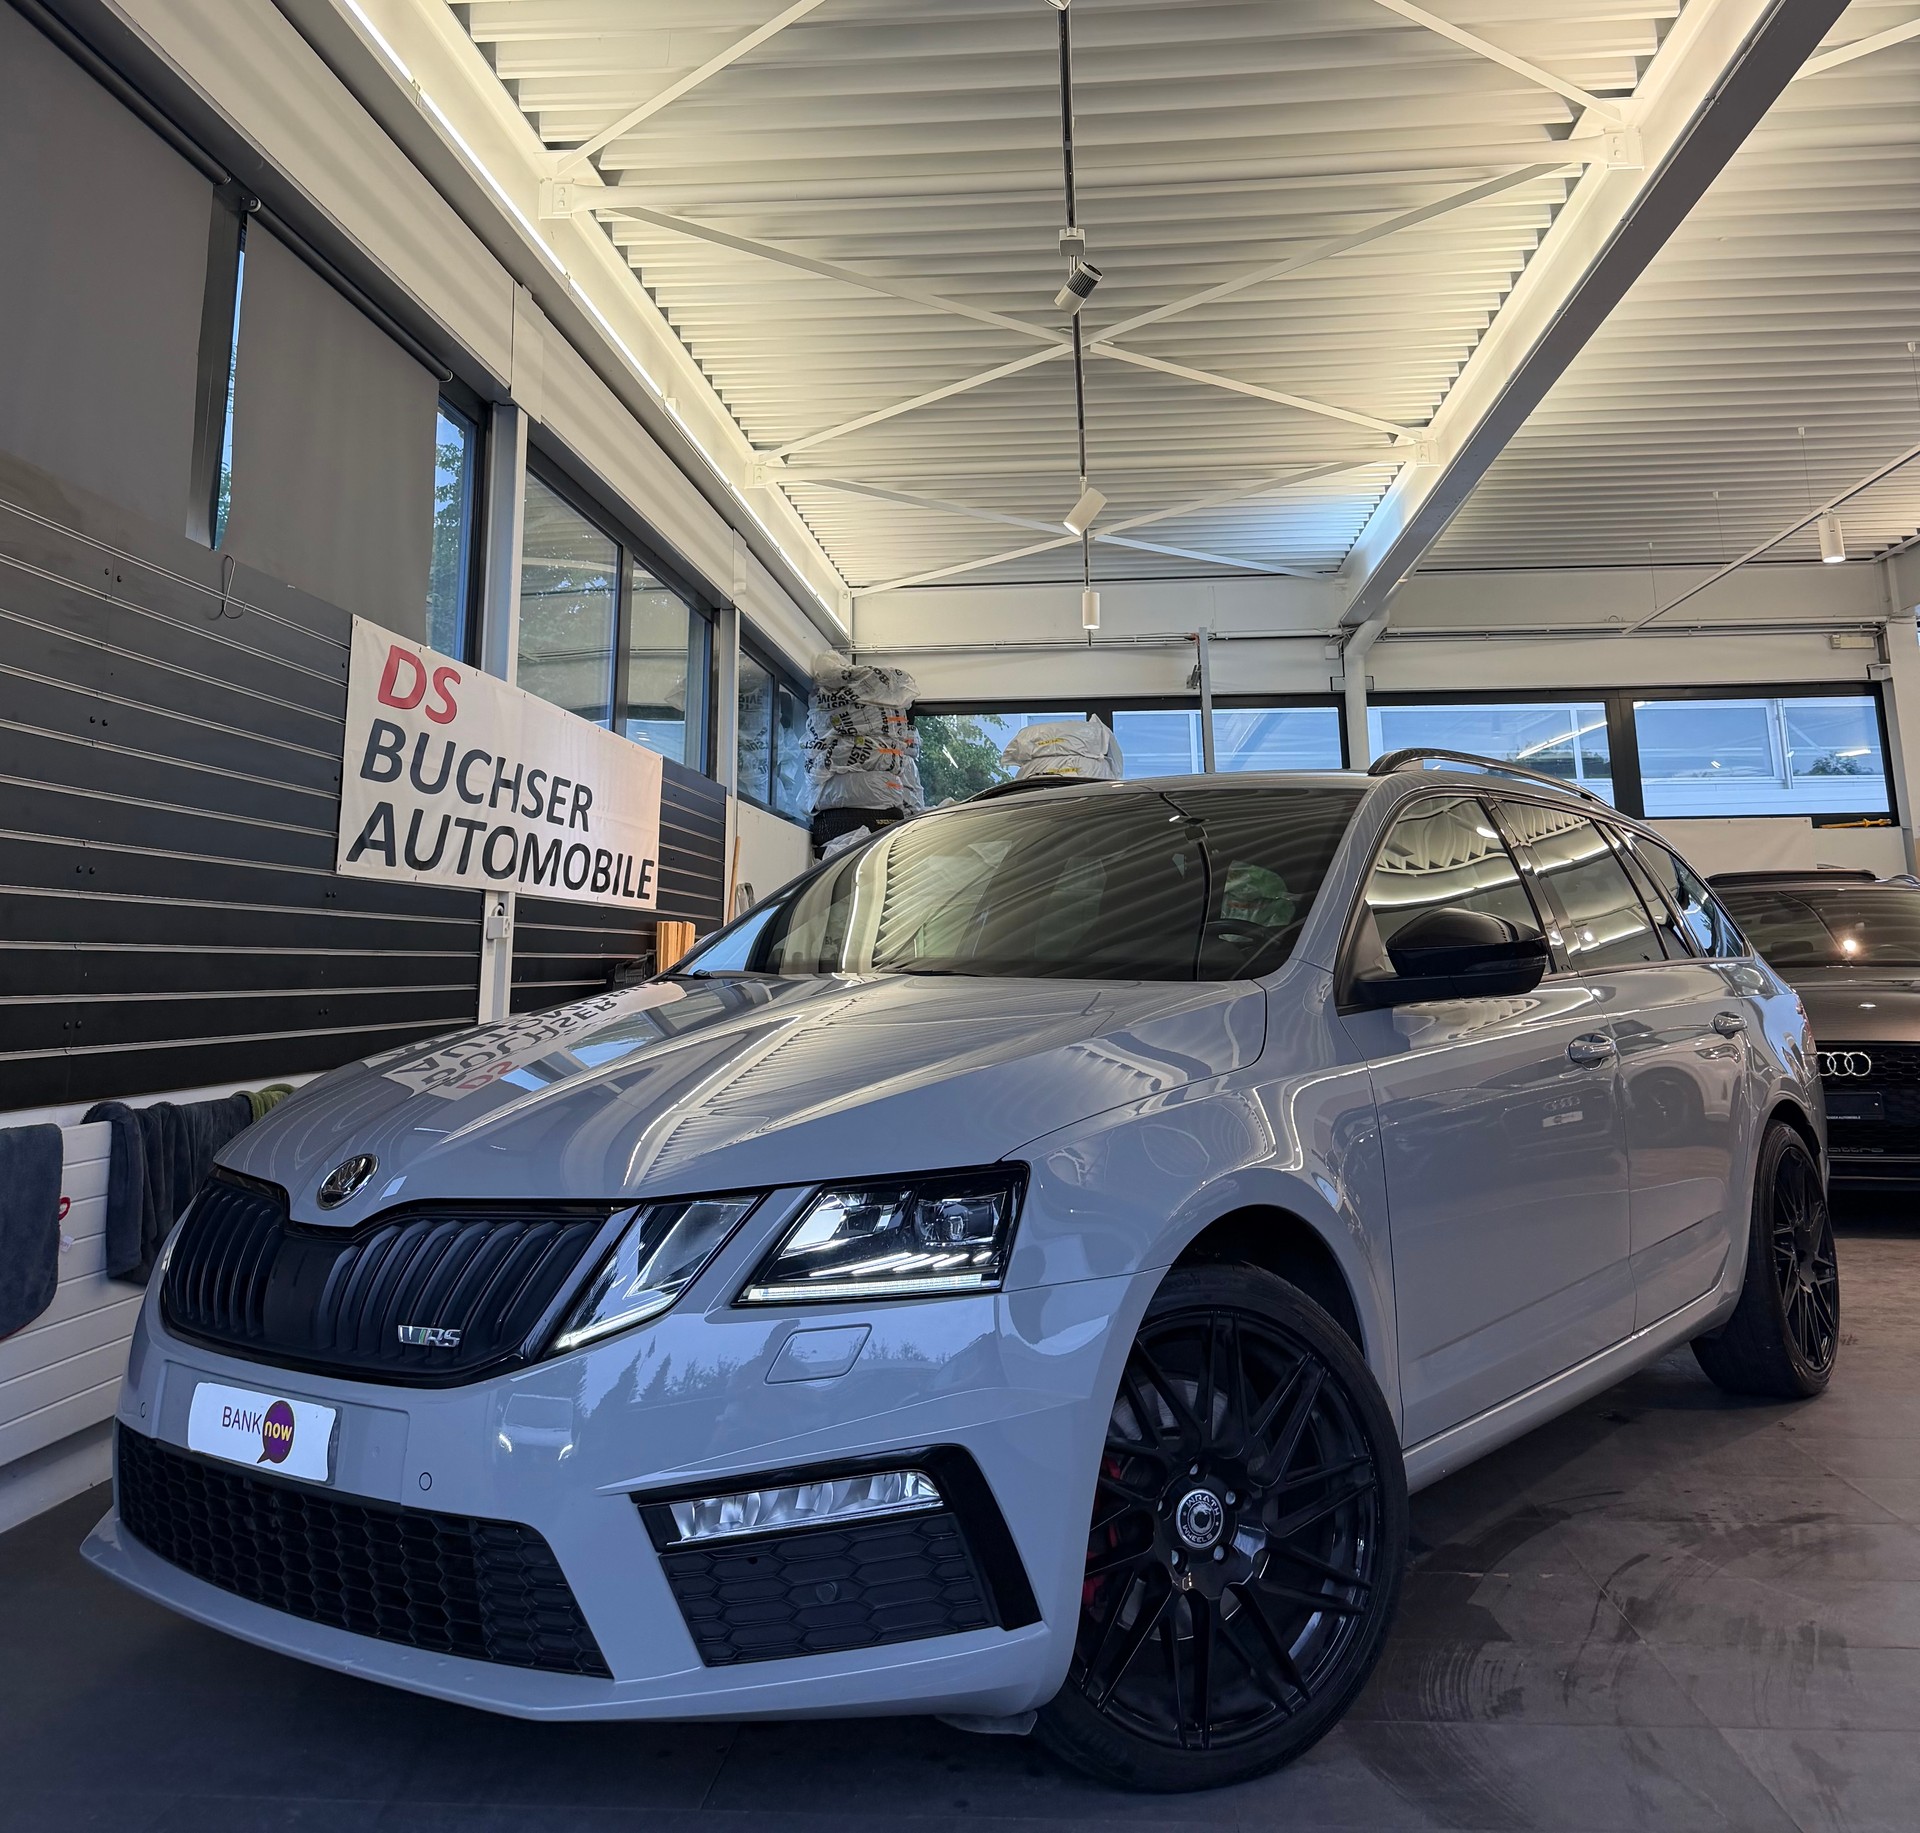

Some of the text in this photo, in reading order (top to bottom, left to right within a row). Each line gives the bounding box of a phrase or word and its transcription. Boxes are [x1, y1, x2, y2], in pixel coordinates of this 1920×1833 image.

[377, 644, 462, 725] DS
[846, 744, 862, 767] UST
[359, 717, 594, 832] BUCHSER
[346, 801, 656, 900] AUTOMOBILE
[222, 1405, 293, 1442] BANK now
[1185, 1493, 1221, 1516] WRATH
[1182, 1524, 1213, 1543] WHEELS
